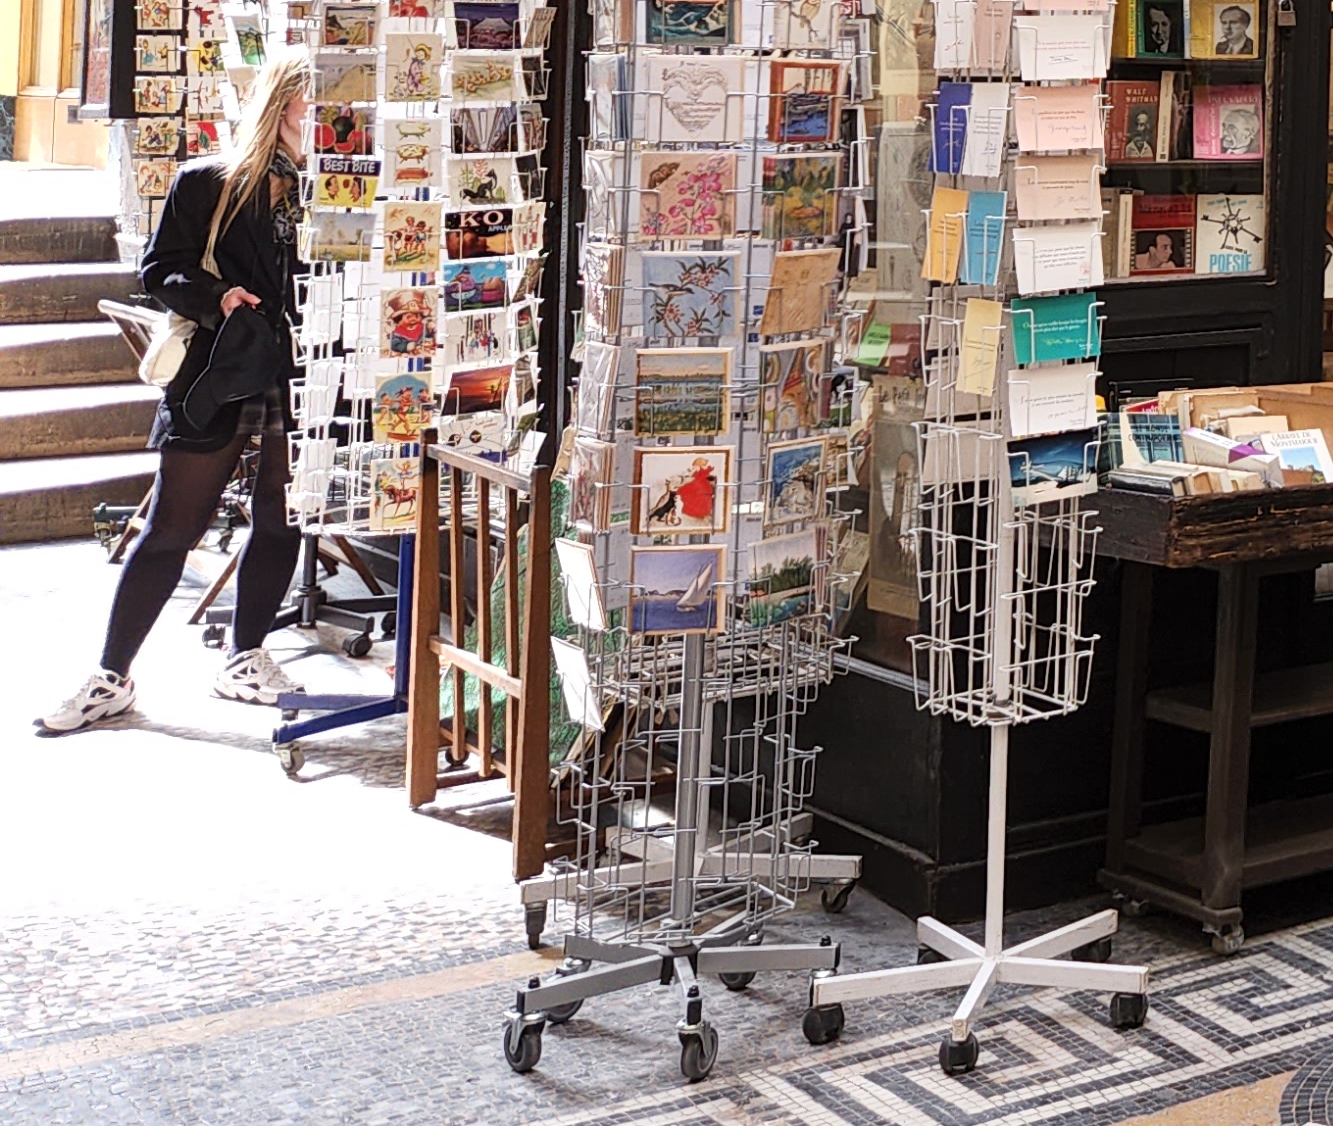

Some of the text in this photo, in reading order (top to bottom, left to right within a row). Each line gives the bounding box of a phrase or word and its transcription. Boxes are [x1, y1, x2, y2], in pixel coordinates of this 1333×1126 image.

[1125, 95, 1158, 103] WHITMAN
[323, 158, 376, 174] BEST BITE
